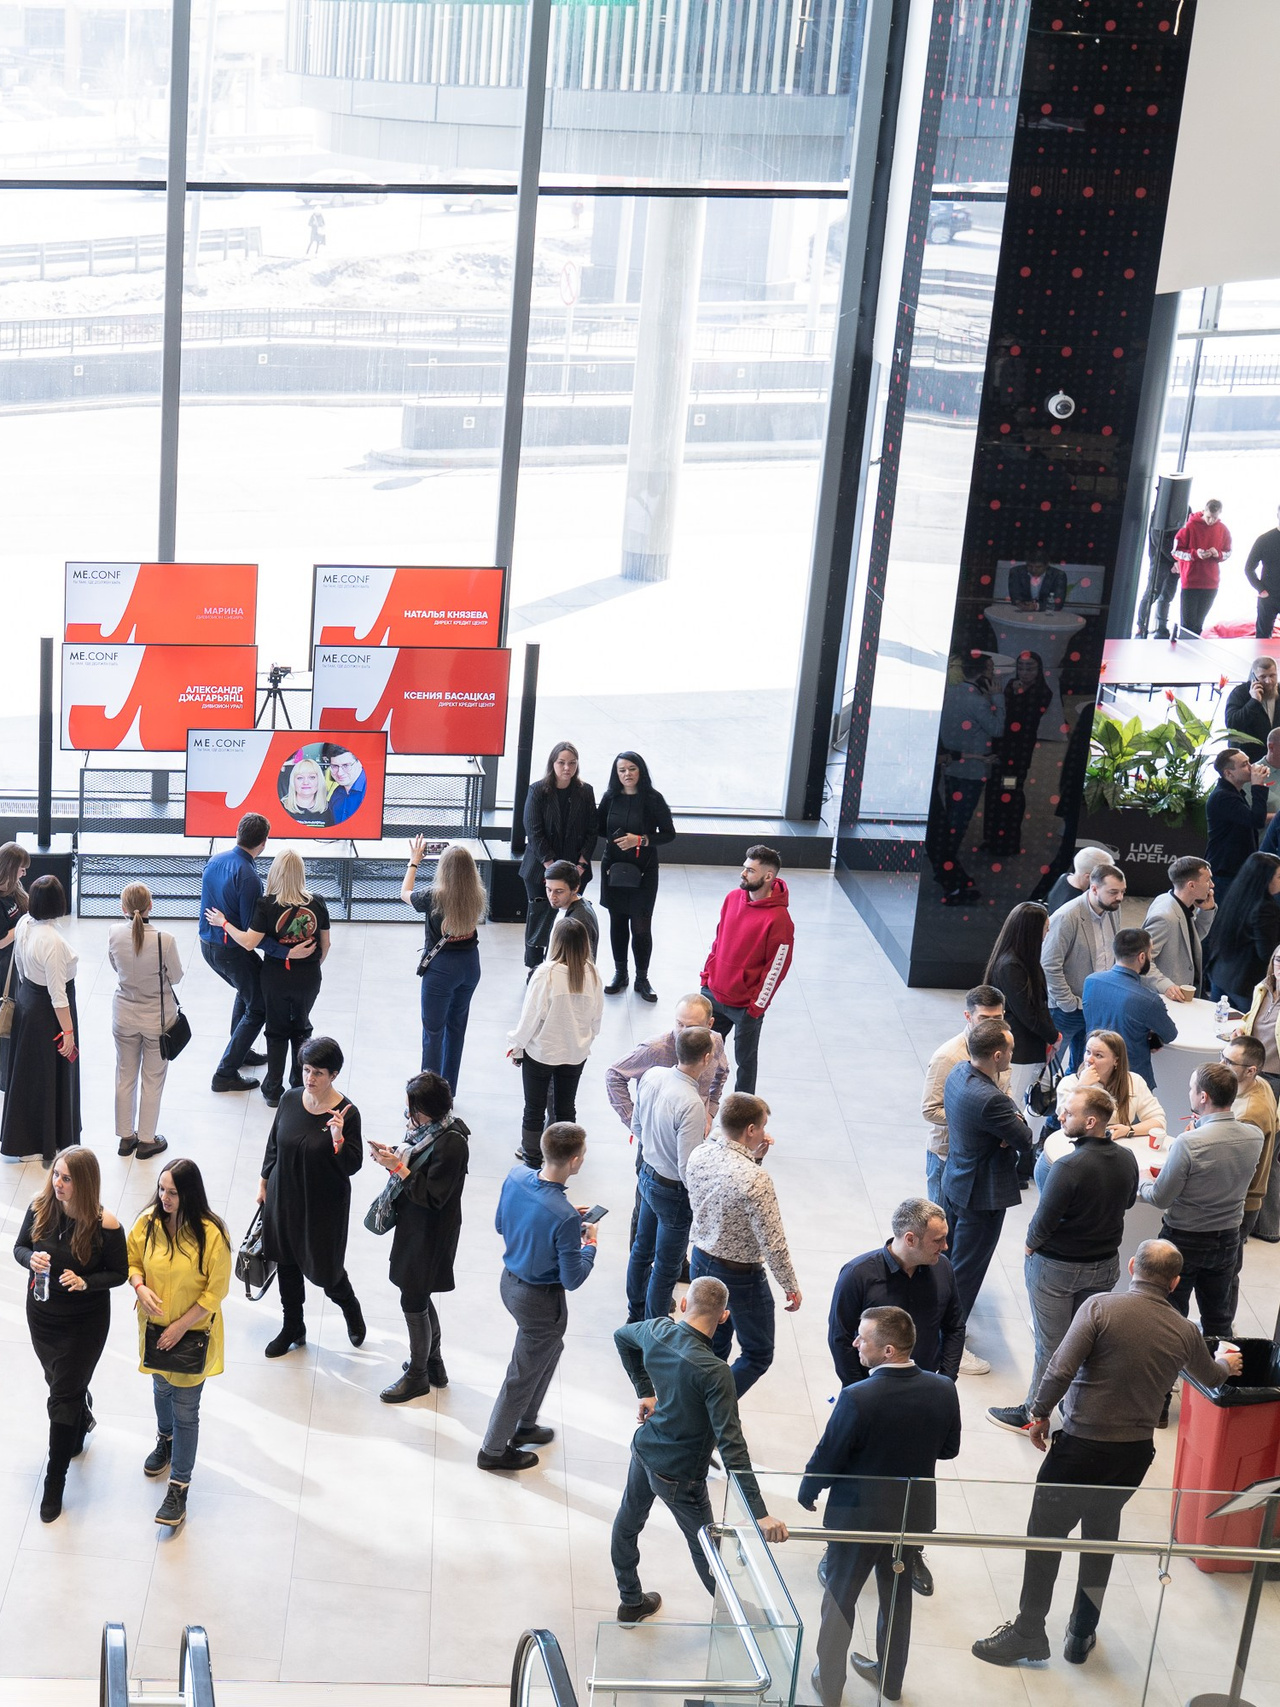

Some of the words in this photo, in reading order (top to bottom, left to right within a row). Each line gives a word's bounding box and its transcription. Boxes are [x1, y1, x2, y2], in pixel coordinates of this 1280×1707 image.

[73, 570, 121, 579] ME.CONF
[323, 574, 370, 583] ME.CONF
[204, 607, 244, 615] МАРИНА
[404, 610, 445, 618] НАТАЛЬЯ
[447, 611, 488, 619] КНЯЗЕВА
[69, 652, 118, 661] ME.CONF
[322, 654, 371, 663] ME.CONF
[186, 685, 244, 694] АЛЕКСАНДР
[178, 694, 244, 703] ДЖАГАРЬЯНЦ
[404, 691, 443, 699] КСЕНИЯ
[445, 692, 495, 701] БАСАЦКАЯ
[194, 739, 246, 748] ME.CONF
[1130, 843, 1164, 854] LIVE
[1125, 852, 1180, 864] АРЕНА
